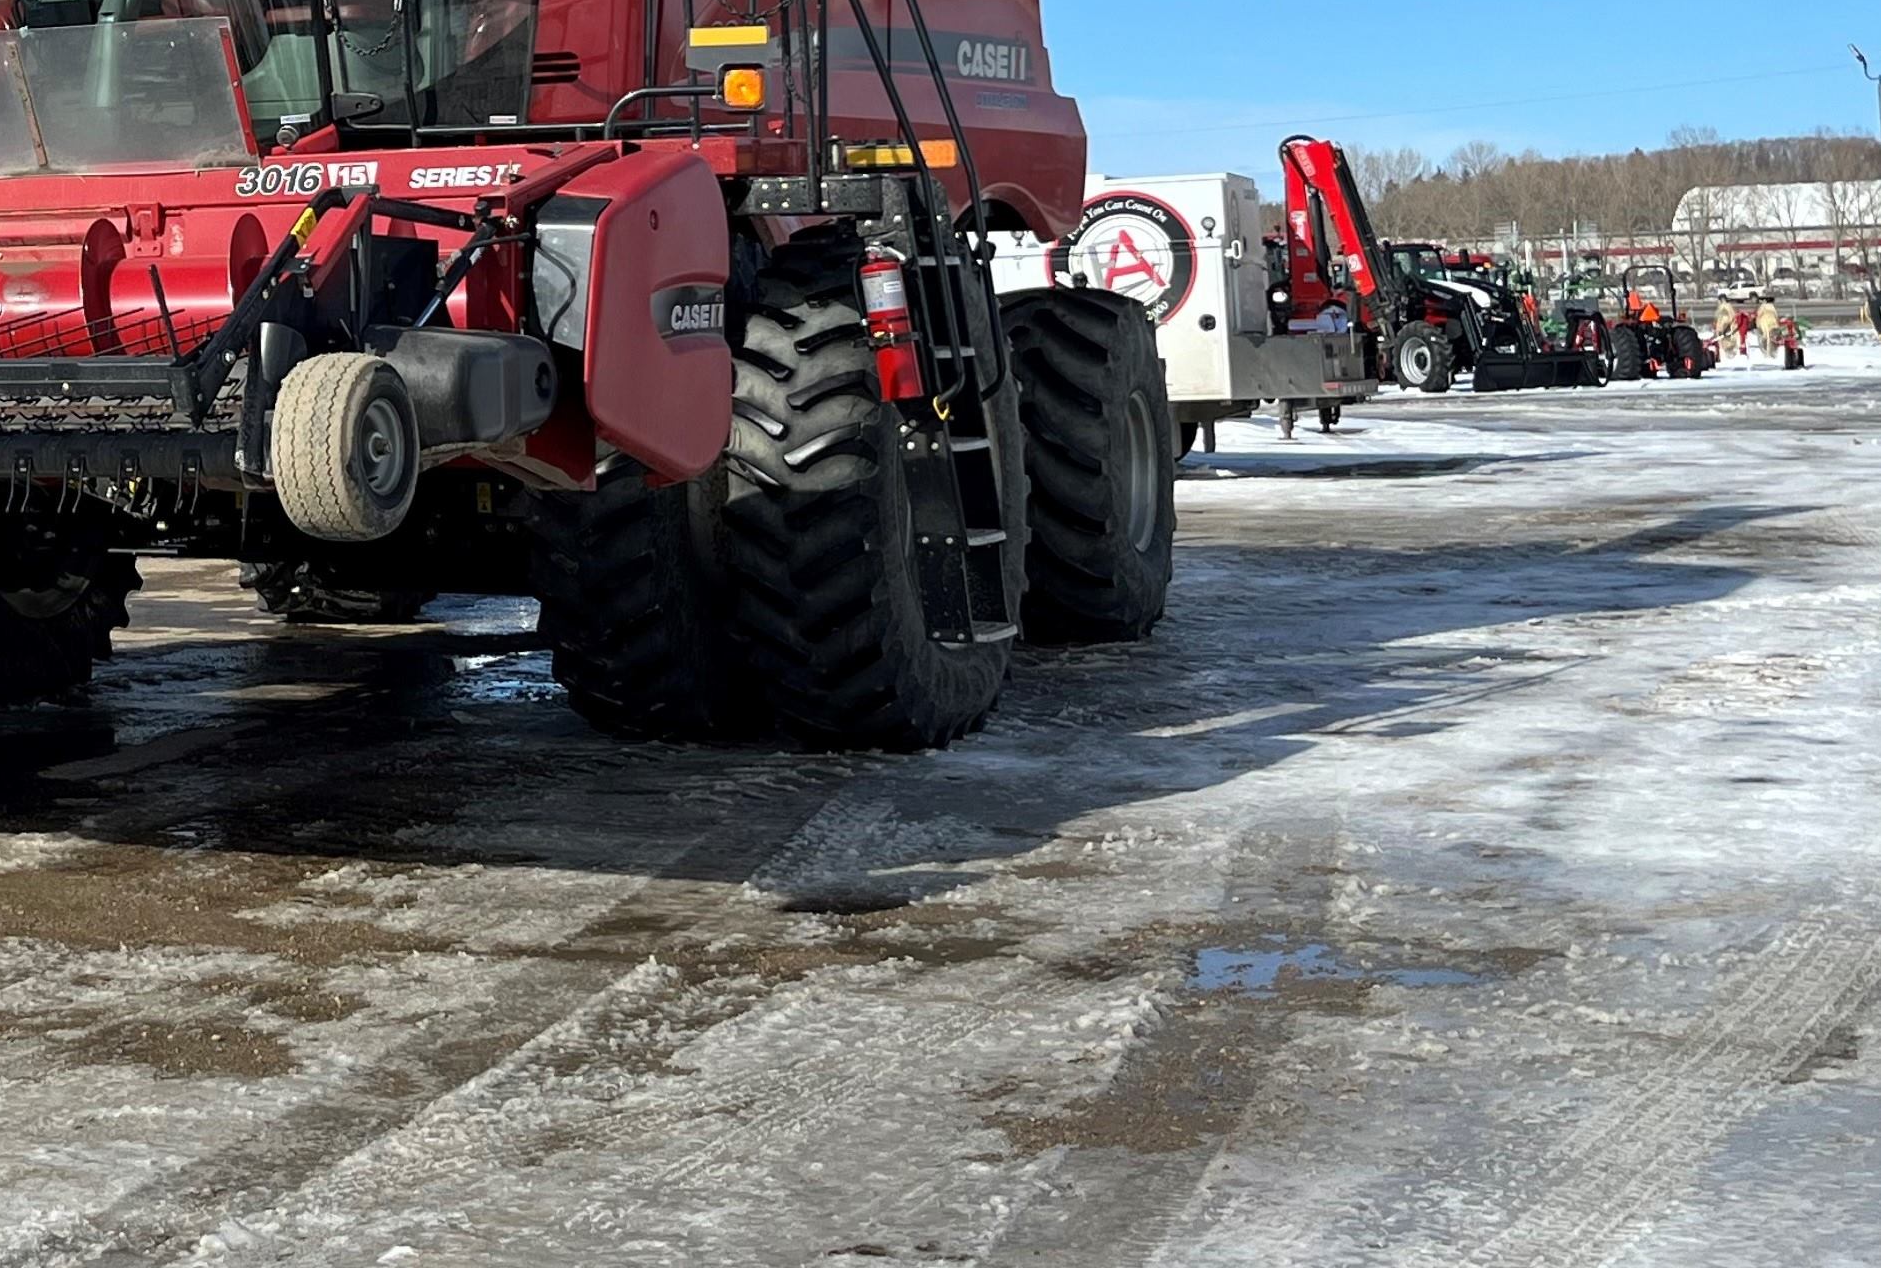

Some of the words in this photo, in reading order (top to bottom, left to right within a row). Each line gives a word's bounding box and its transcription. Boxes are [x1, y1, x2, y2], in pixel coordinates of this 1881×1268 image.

[957, 40, 1009, 79] CASE
[235, 162, 324, 196] 3016
[338, 164, 369, 187] 15
[409, 165, 492, 189] SERIES
[671, 304, 710, 331] CASE
